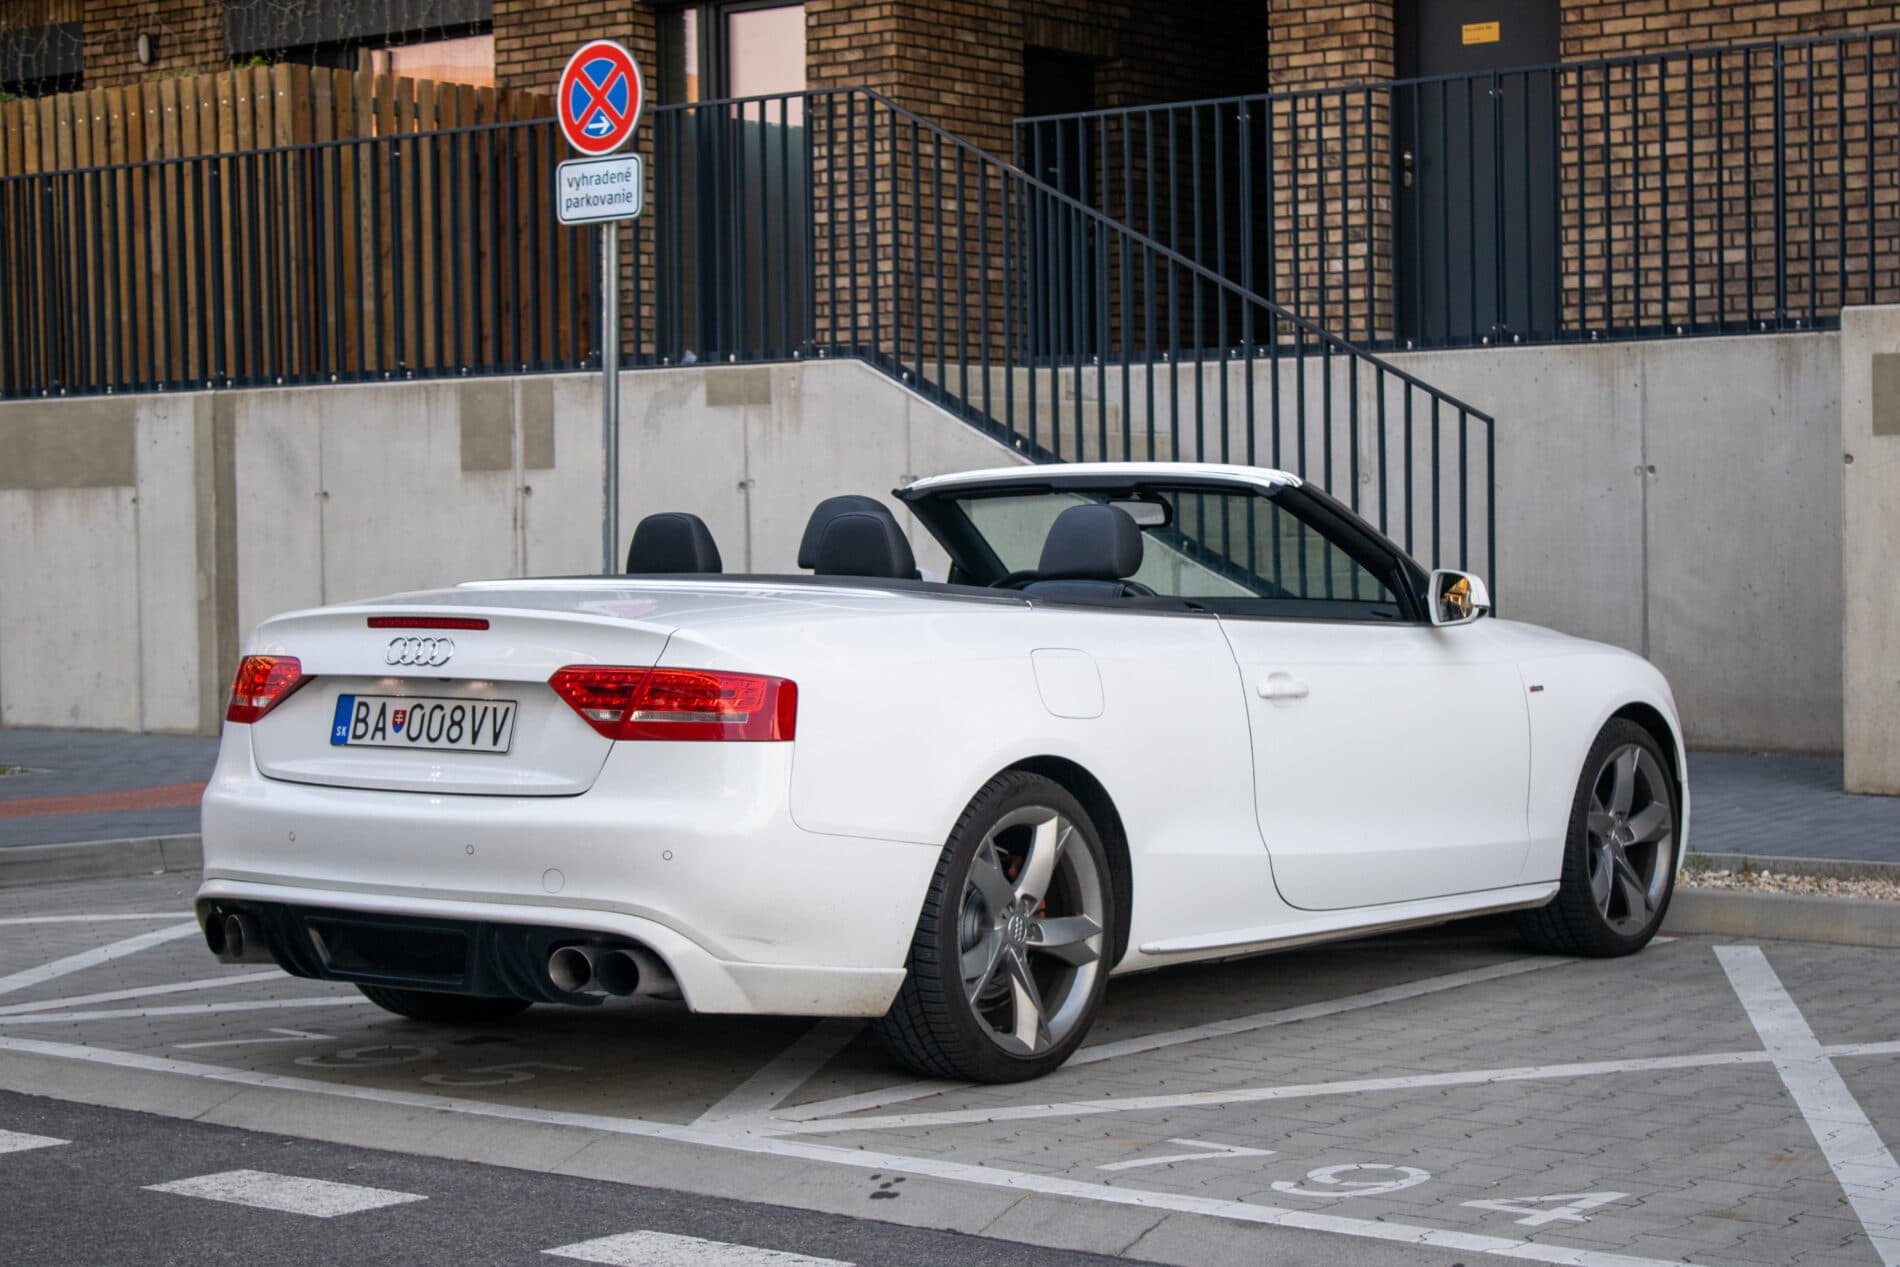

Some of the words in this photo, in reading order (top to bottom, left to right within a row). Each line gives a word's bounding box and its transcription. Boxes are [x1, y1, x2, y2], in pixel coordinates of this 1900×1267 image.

[567, 167, 632, 191] vyhradené
[565, 188, 633, 212] parkovanie
[335, 726, 347, 737] SK
[351, 701, 387, 741] BA
[406, 703, 510, 747] 008VV
